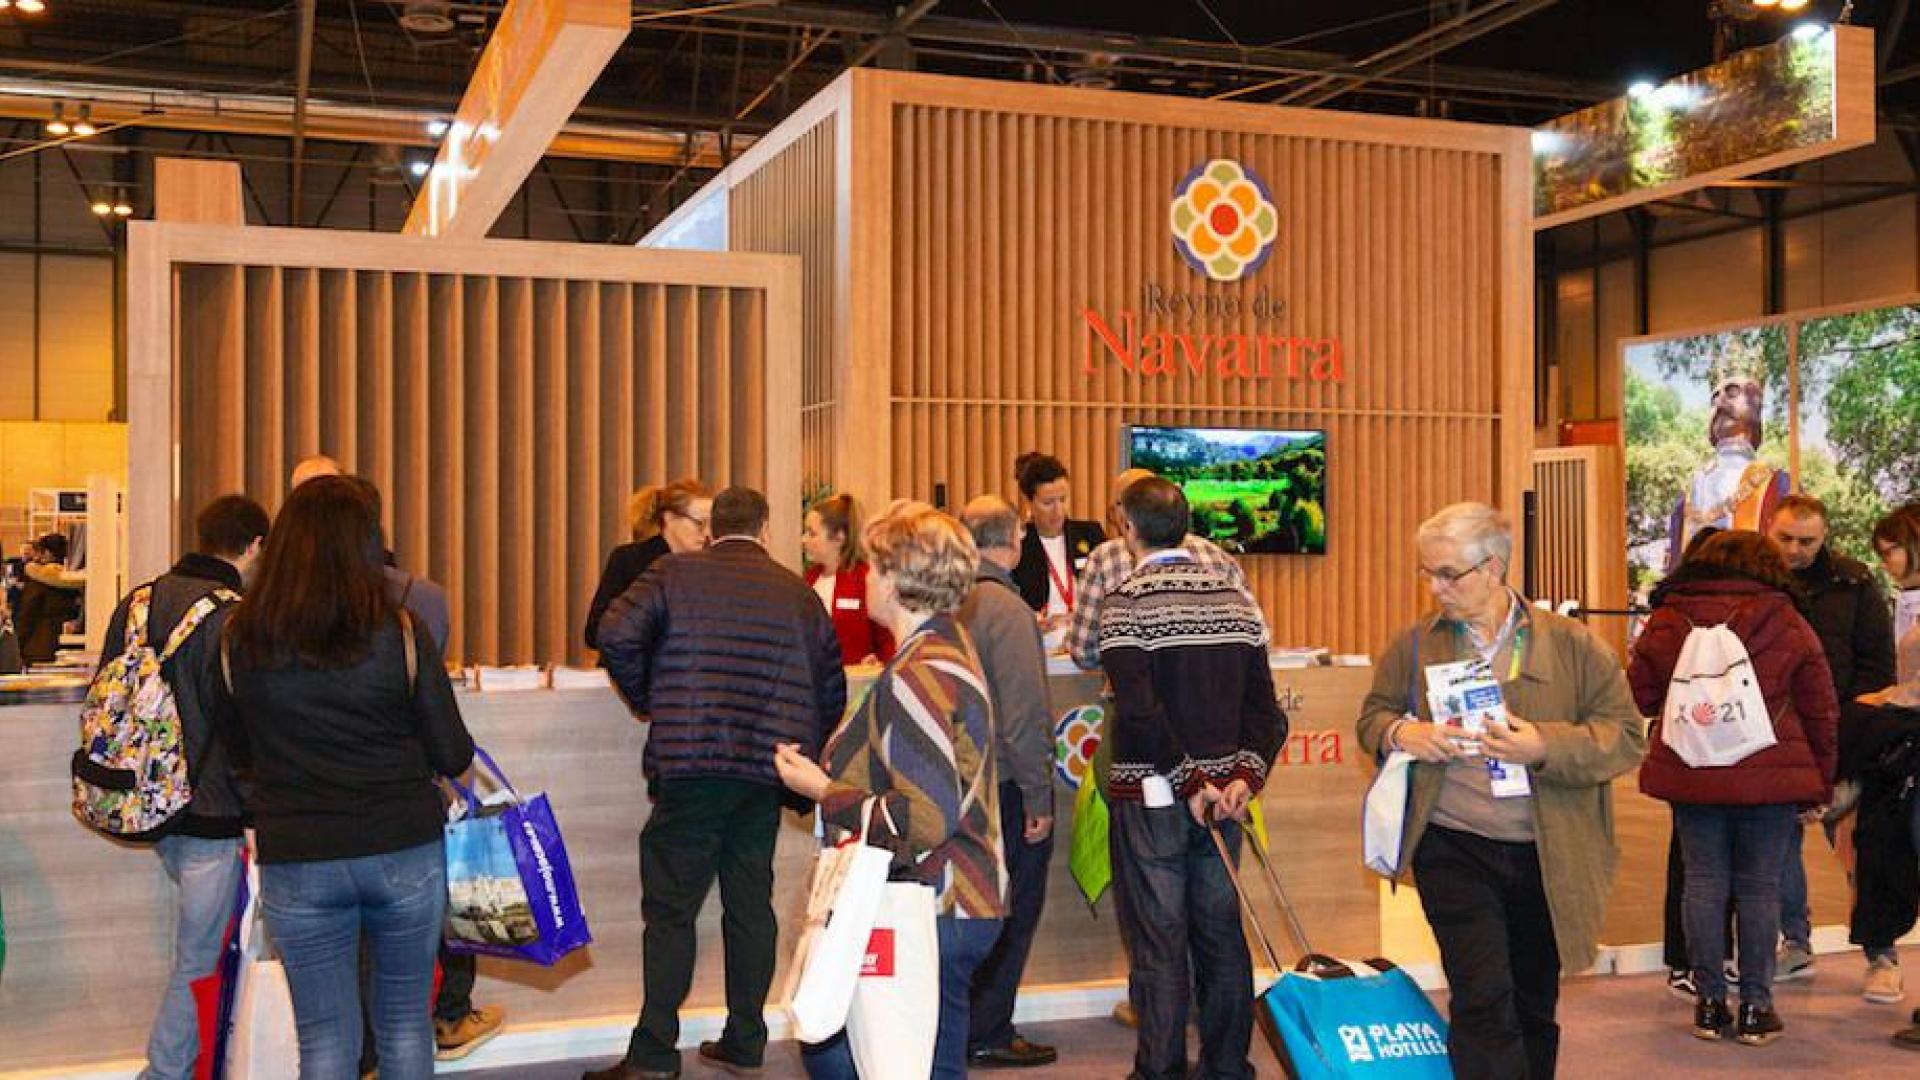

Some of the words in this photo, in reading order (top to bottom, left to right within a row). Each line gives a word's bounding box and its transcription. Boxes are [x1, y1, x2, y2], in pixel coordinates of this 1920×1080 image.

[1144, 283, 1242, 323] Reyno
[1252, 284, 1286, 318] de
[1081, 306, 1345, 384] Navarra
[1277, 686, 1303, 710] de
[1720, 699, 1746, 722] 21
[1368, 1022, 1440, 1043] PLAYA
